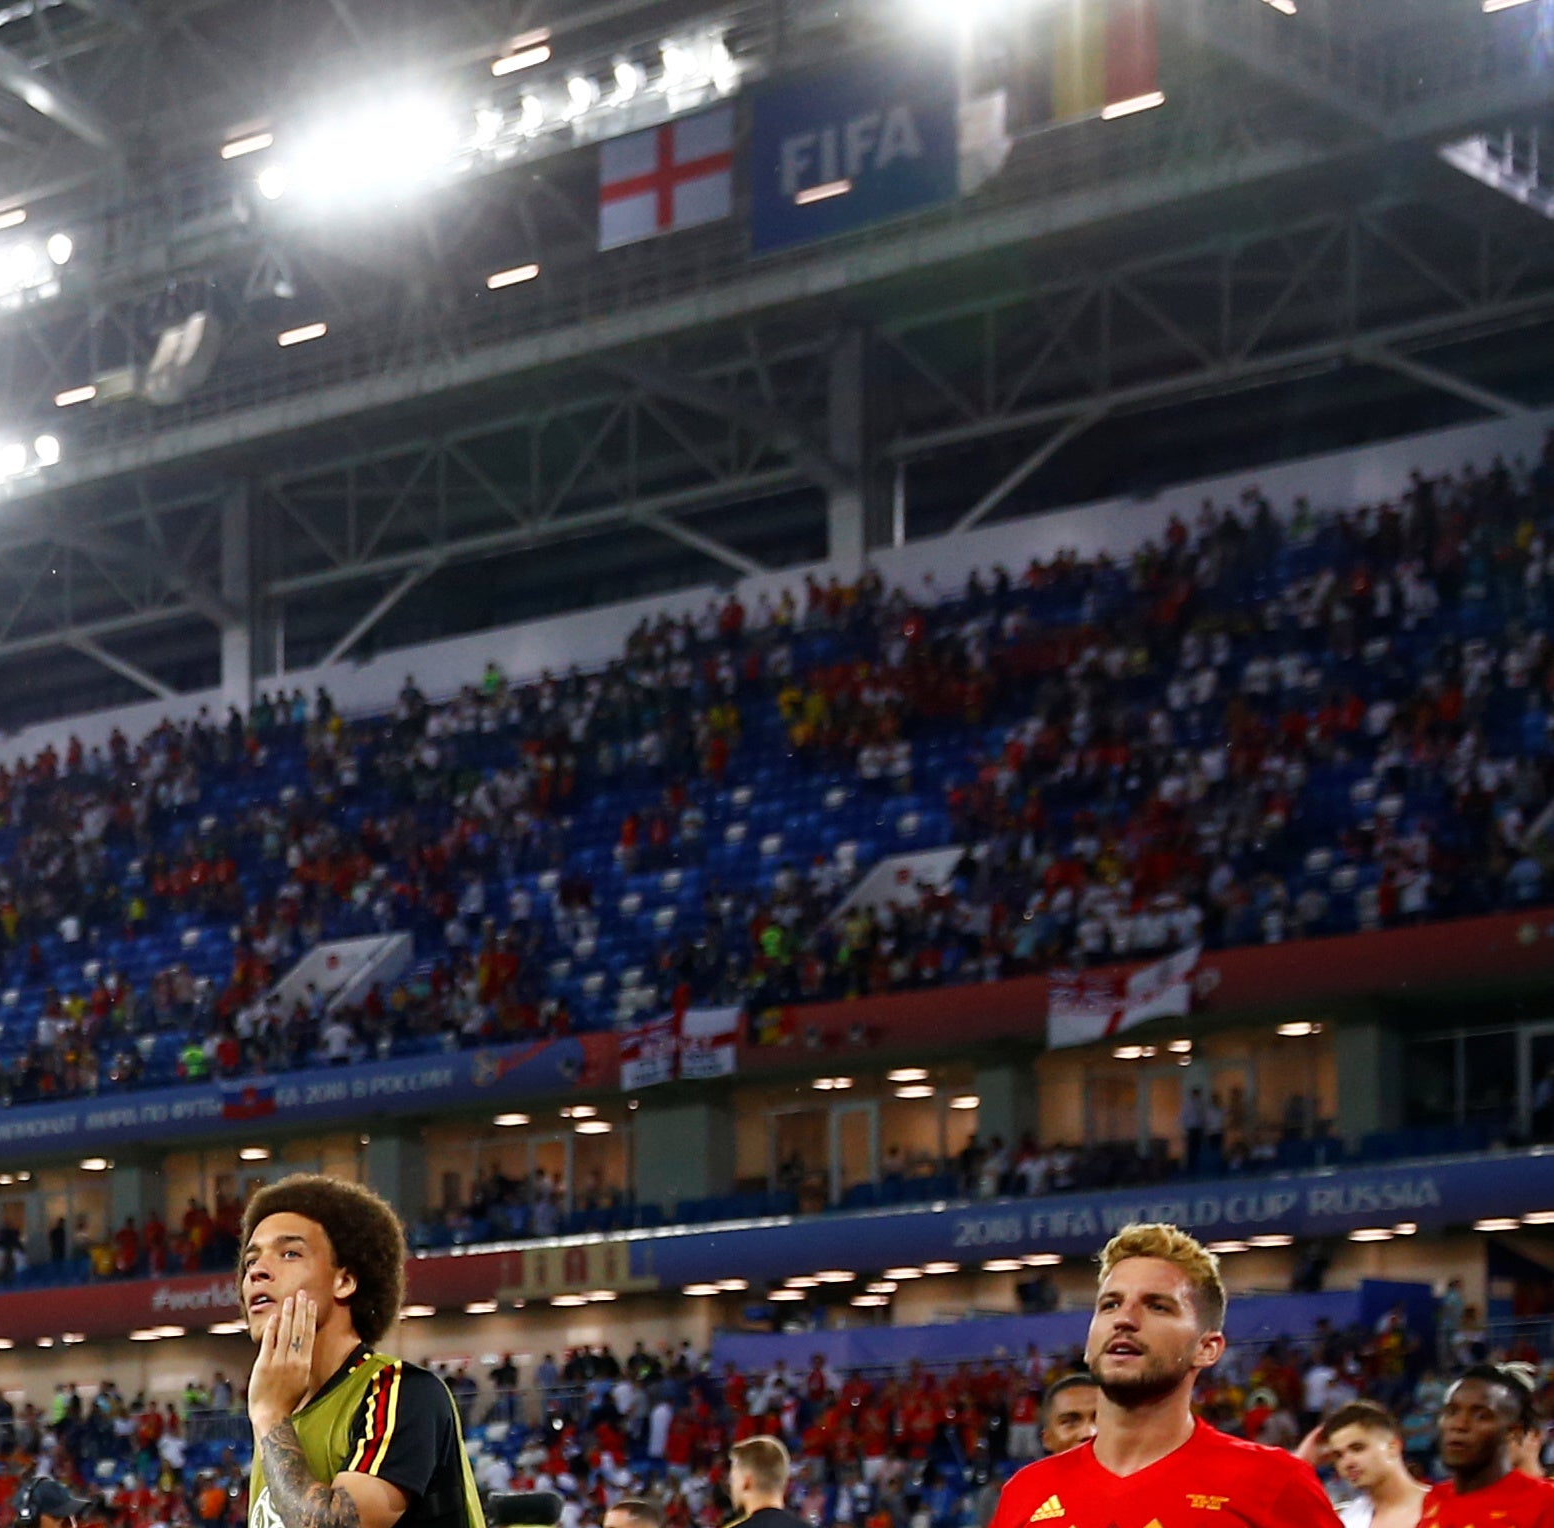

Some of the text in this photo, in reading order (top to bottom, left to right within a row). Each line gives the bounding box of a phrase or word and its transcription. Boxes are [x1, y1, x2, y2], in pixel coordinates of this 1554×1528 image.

[780, 106, 922, 196] FIFA
[953, 1216, 1023, 1247] 2018
[1029, 1210, 1098, 1240] FIFA
[1224, 1191, 1297, 1224] CUP
[1305, 1175, 1440, 1217] RUSSIA
